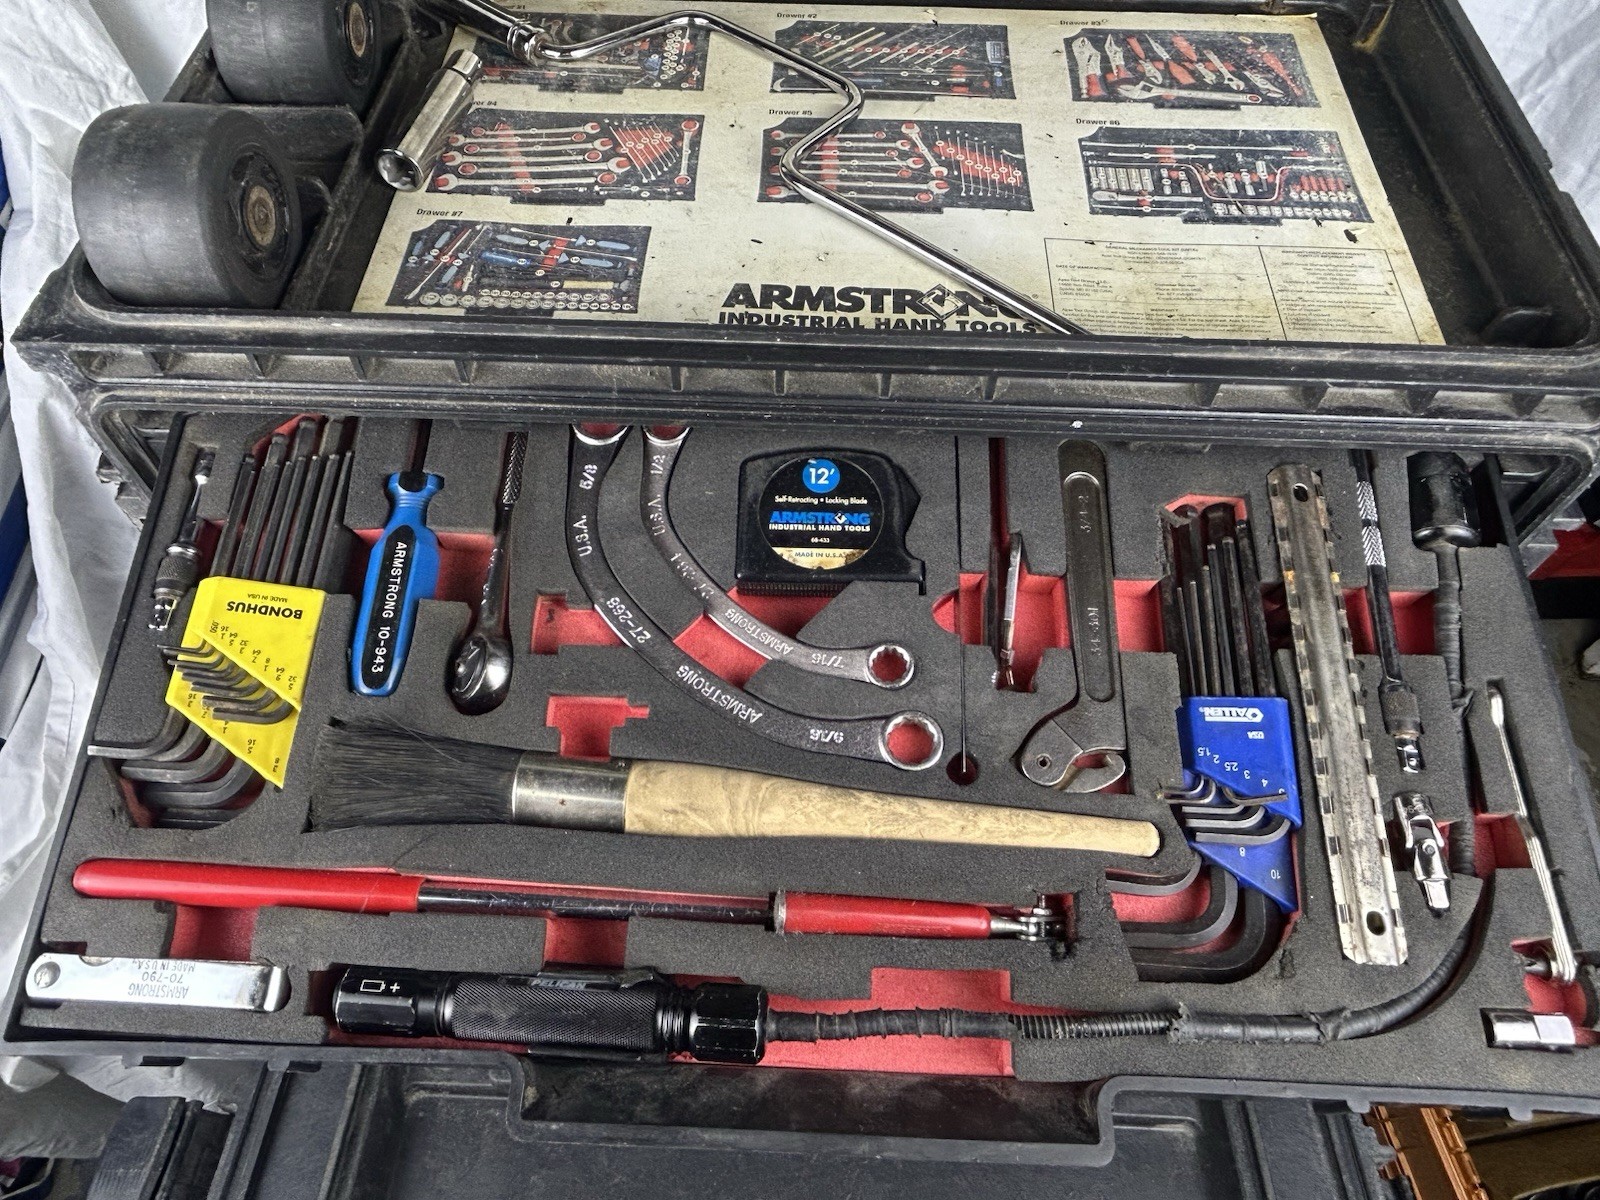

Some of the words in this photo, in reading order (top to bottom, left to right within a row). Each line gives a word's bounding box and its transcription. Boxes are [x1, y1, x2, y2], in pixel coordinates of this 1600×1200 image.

[416, 208, 450, 217] Drawer
[718, 311, 865, 329] INDUSTRIAL
[875, 317, 946, 331] HAND
[956, 319, 1037, 333] TOOLS
[774, 495, 819, 505] Self-Retracting
[825, 496, 849, 506] Locking
[850, 497, 868, 505] Blade
[769, 510, 872, 525] ARMSTRONG
[768, 523, 817, 531] INDUSTRIAL
[818, 524, 842, 532] HAND
[573, 515, 593, 557] U.S.A.
[381, 541, 408, 619] ARMSTRONG
[247, 593, 261, 601] USA
[269, 596, 289, 604] MADE
[226, 601, 304, 620] BONDHUS
[605, 597, 652, 644] 27-268
[725, 607, 794, 655] ARMSTRONG
[371, 626, 391, 673] 10-943
[676, 664, 764, 725] ARMSTRONG
[1204, 706, 1248, 718] ALLEN
[809, 727, 845, 744] 9/16
[1247, 731, 1265, 740] USA
[1213, 754, 1220, 764] 2
[1243, 769, 1251, 780] 3
[1261, 778, 1269, 788] 4
[1239, 847, 1246, 857] 8
[1270, 868, 1281, 880] 10
[160, 960, 170, 970] IN
[172, 961, 196, 973] MADE
[141, 971, 184, 984] 70-790
[127, 983, 190, 999] ARMSTRONG
